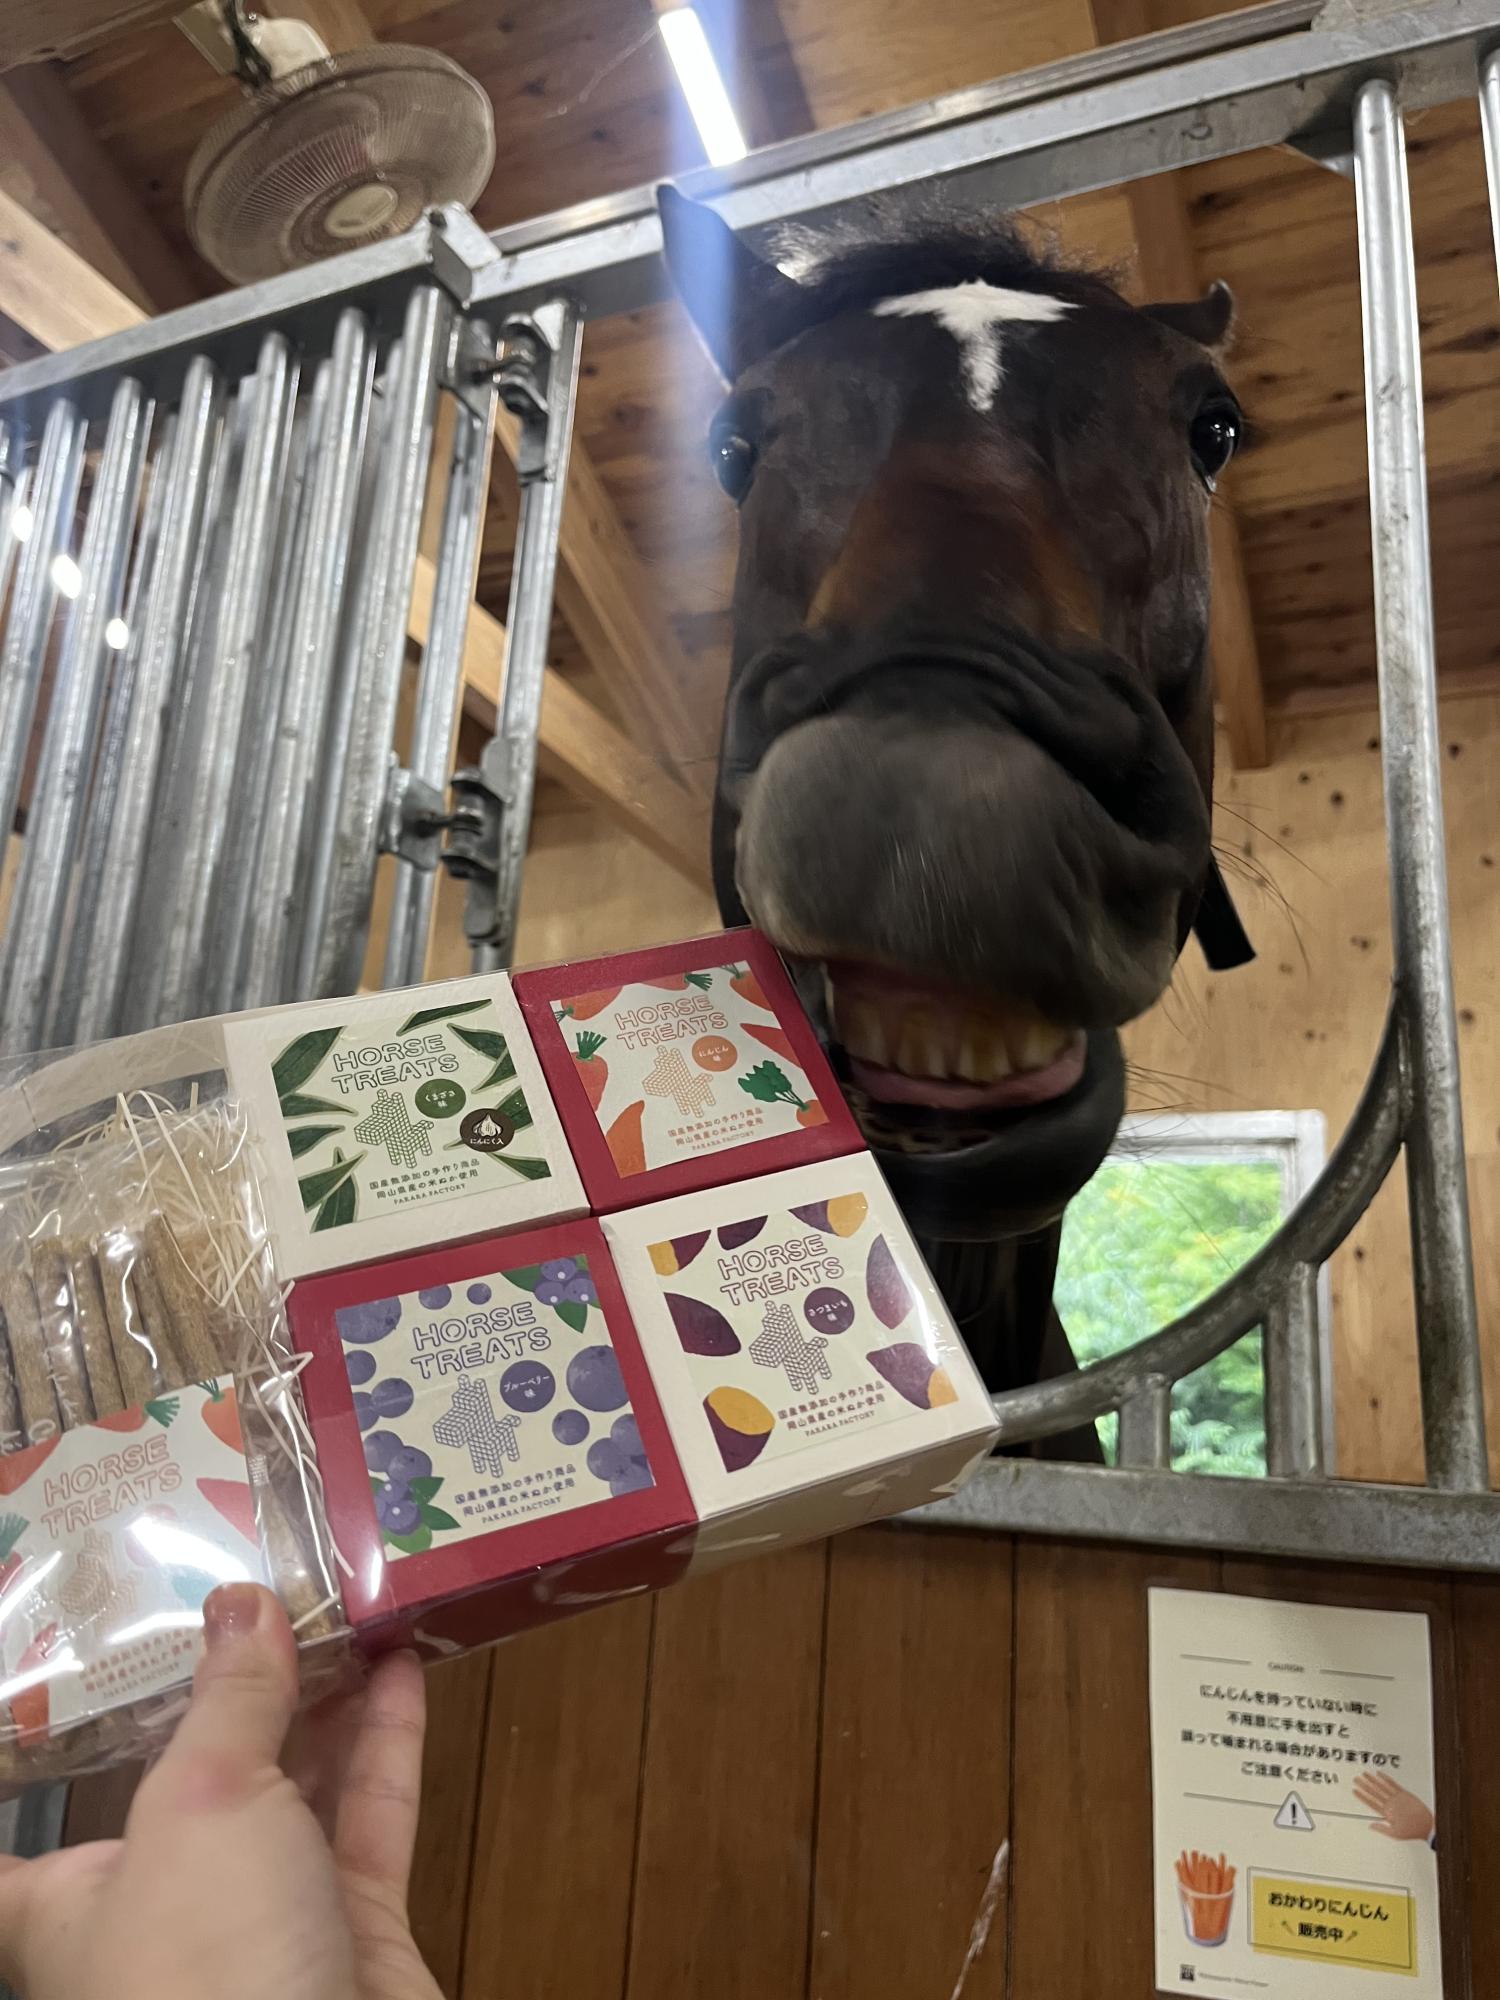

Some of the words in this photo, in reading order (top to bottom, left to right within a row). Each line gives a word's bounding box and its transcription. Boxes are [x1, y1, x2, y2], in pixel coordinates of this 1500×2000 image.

[614, 994, 714, 1030] HORSE
[616, 1012, 729, 1050] TREATS
[333, 1034, 446, 1072] HORSE
[699, 1046, 729, 1058] にんじん
[331, 1054, 459, 1094] TREATS
[369, 1158, 480, 1190] 国産無添加の手作り商品
[376, 1169, 479, 1199] 岡山県産の米ぬか使用
[717, 1234, 828, 1280] HORSE
[720, 1257, 844, 1306] TREATS
[412, 1301, 537, 1351] HORSE
[808, 1300, 848, 1317] さつまいも
[411, 1326, 552, 1380] TREATS
[503, 1375, 550, 1392] ブルーベリー
[777, 1380, 885, 1420] 国産無添加の手作り商品
[786, 1393, 886, 1431] 岡山県産の米ぬか使用
[44, 1433, 170, 1507] HORSE
[454, 1463, 577, 1505] 国産無添加の手作り商品
[40, 1462, 183, 1539] TREATS
[462, 1477, 576, 1517] 岡山県産の米ぬか使用
[1199, 1684, 1378, 1717] にんじんを持っていない時に
[1226, 1710, 1350, 1739] 不用意に手を出すと
[1240, 1760, 1339, 1785] ご注意ください
[1267, 1891, 1389, 1922] おかわりにんじん
[1297, 1921, 1344, 1942] 販売中
